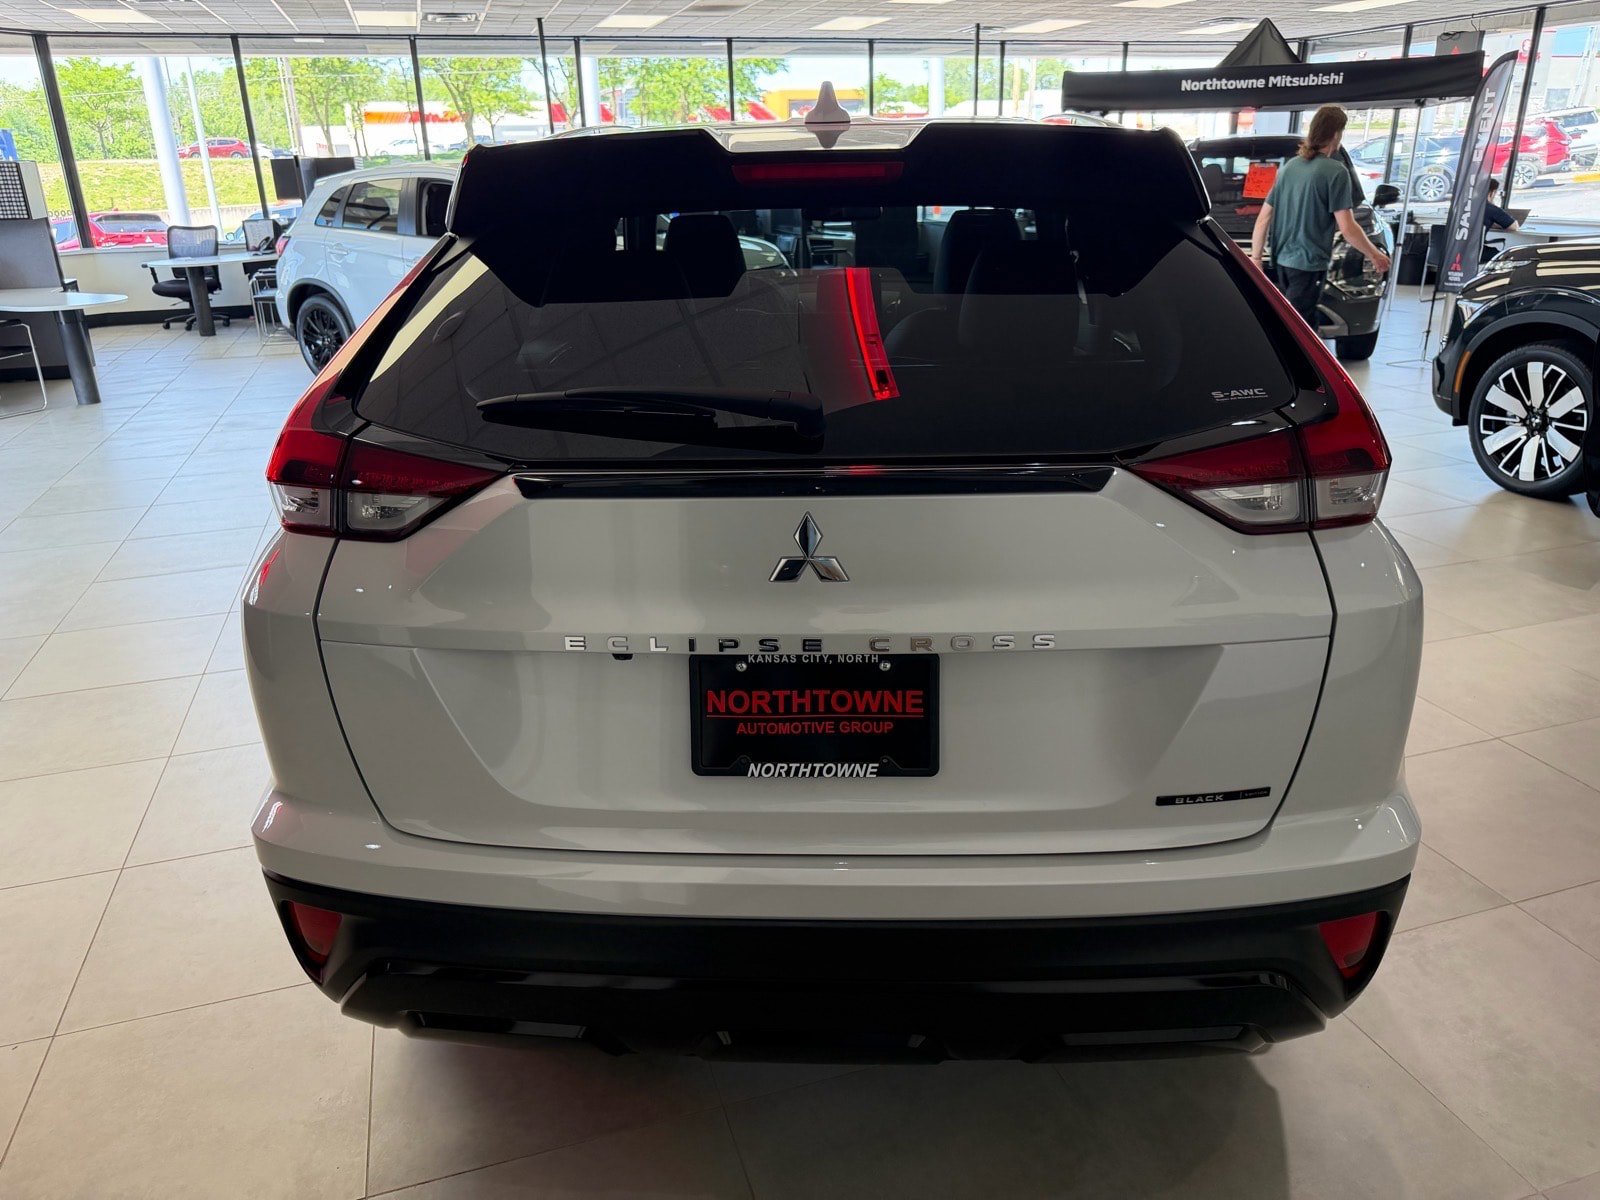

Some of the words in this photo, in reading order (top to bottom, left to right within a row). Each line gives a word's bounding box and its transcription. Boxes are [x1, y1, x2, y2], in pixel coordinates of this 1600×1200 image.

[1180, 78, 1265, 91] Northtowne
[1268, 72, 1344, 88] Mitsubishi
[1211, 388, 1266, 398] S-AWC
[564, 636, 823, 653] ECLIPSE
[869, 634, 1056, 652] CROSS
[748, 654, 797, 663] KANSAS
[802, 654, 832, 664] CITY,
[837, 654, 879, 663] NORTH
[707, 690, 924, 713] NORTHTOWNE
[736, 722, 835, 735] AUTOMOTIVE
[839, 721, 894, 734] GROUP
[747, 763, 879, 778] NORTHTOWNE
[1175, 794, 1224, 804] BLACK
